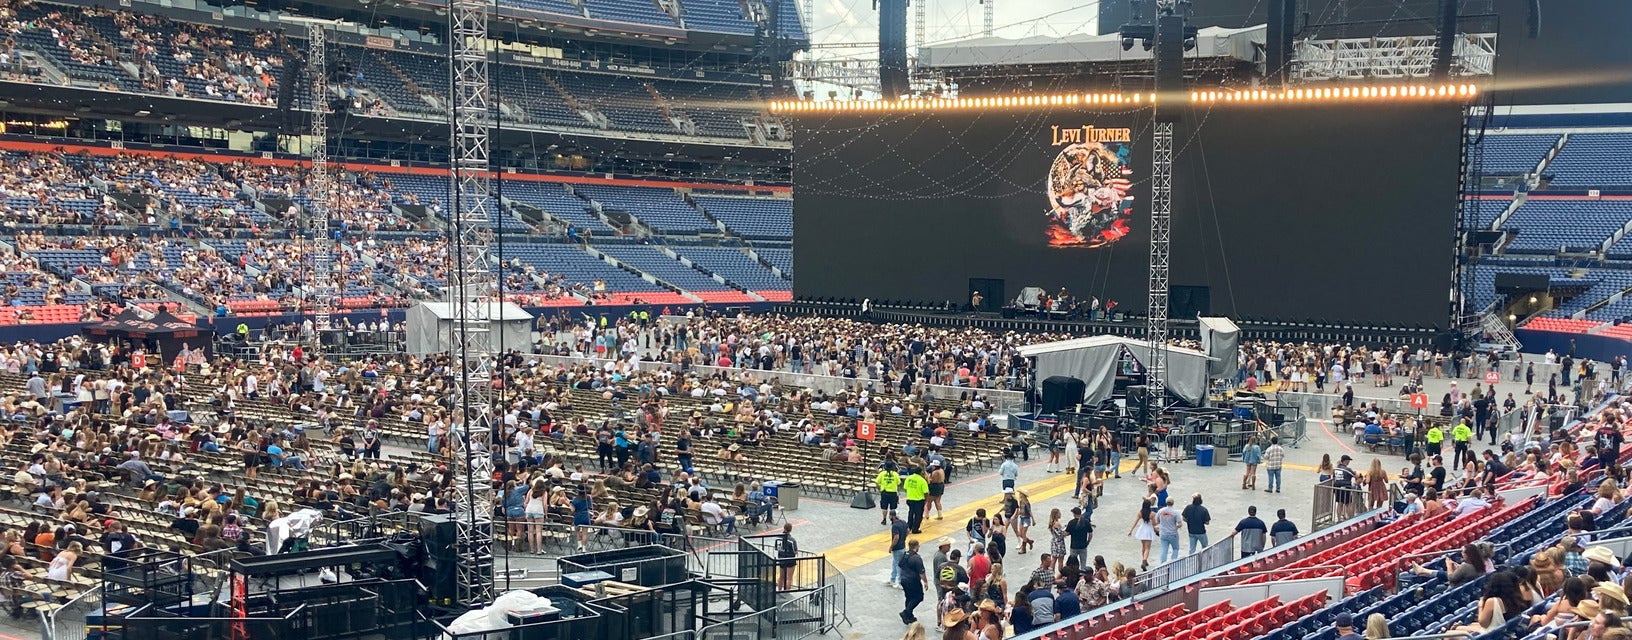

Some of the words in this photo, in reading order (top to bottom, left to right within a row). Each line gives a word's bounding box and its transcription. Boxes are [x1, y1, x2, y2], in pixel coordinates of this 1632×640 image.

[134, 356, 140, 364] D
[1415, 396, 1423, 405] A
[861, 424, 870, 436] B
